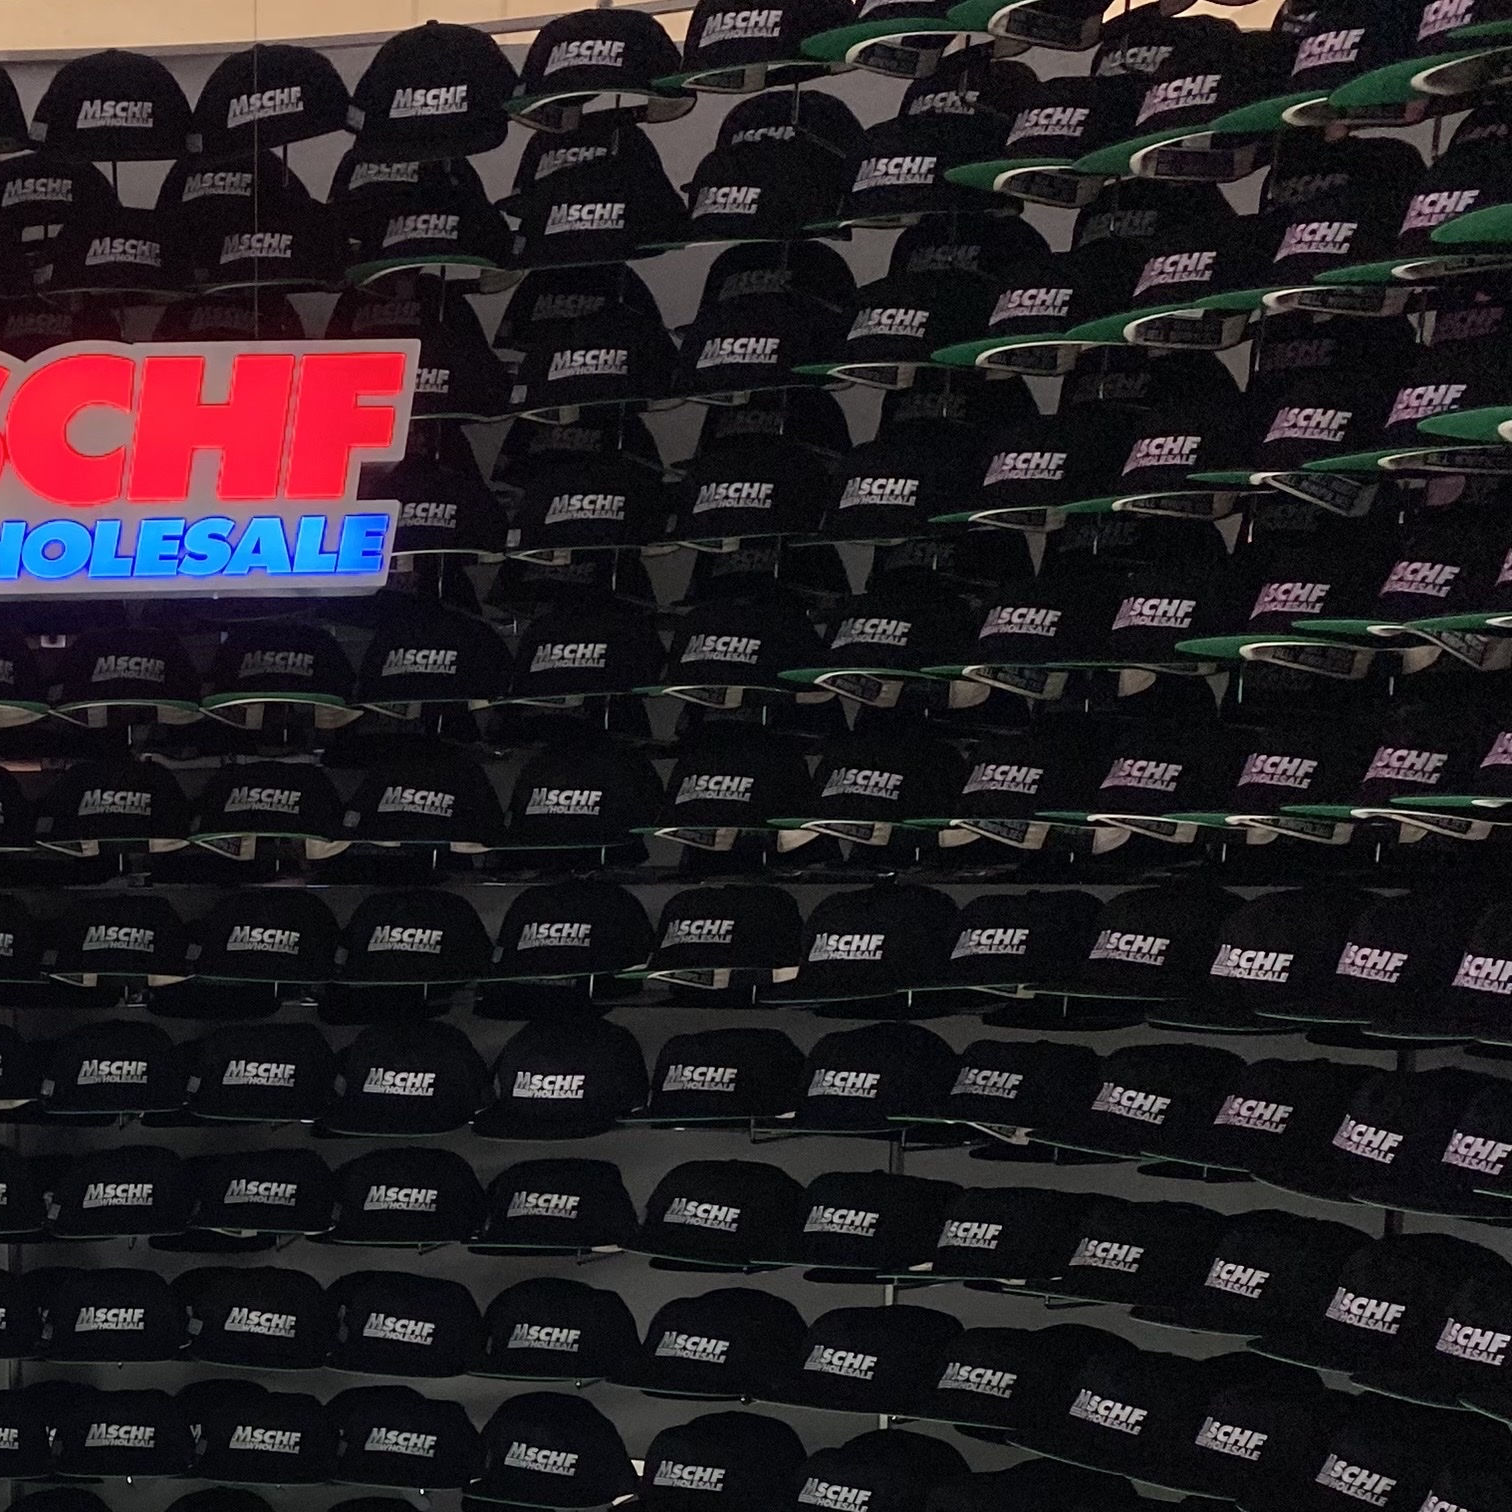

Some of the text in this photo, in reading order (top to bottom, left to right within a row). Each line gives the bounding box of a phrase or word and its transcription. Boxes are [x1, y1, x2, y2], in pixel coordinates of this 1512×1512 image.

[704, 9, 783, 39] MSCHF
[550, 40, 625, 65] MSCHF
[230, 86, 304, 118] MSCHF
[393, 85, 467, 110] MSCHF
[79, 99, 152, 123] MSCHF
[859, 156, 937, 178] MSCHF
[5, 178, 72, 199] MSCHF
[185, 172, 253, 194] MSCHF
[549, 203, 625, 225] MSCHF
[387, 214, 459, 238] MSCHF
[87, 237, 160, 261] MSCHF
[223, 232, 293, 256] MSCHF
[855, 308, 929, 328] MSCHF
[552, 349, 627, 370] MSCHF
[702, 337, 780, 362] MSCHF
[698, 482, 774, 506] MSCHF
[845, 477, 919, 496] MSCHF
[550, 494, 625, 516] MSCHF
[386, 648, 457, 670] MSCHF
[534, 643, 607, 666] MSCHF
[82, 789, 151, 807] MSCHF
[228, 786, 301, 806] MSCHF
[380, 786, 455, 809] MSCHF
[531, 788, 602, 806] MSCHF
[229, 926, 300, 947] MSCHF
[371, 925, 443, 946] MSCHF
[521, 922, 591, 944] MSCHF
[813, 933, 885, 952] MSCHF
[1094, 930, 1170, 956] MSCHF
[1213, 944, 1294, 973] MSCHF
[80, 1059, 147, 1077] MSCHF
[225, 1060, 295, 1079] MSCHF
[367, 1068, 436, 1086] MSCHF
[666, 1064, 737, 1083] MSCHF
[516, 1071, 585, 1089] MSCHF
[812, 1069, 880, 1090] MSCHF
[86, 1183, 153, 1200] MSCHF
[227, 1179, 297, 1198] MSCHF
[367, 1185, 438, 1204] MSCHF
[511, 1191, 580, 1210] MSCHF
[670, 1198, 740, 1223] MSCHF
[807, 1205, 879, 1228] MSCHF
[78, 1307, 144, 1324] MSCHF
[225, 1307, 296, 1331] MSCHF
[364, 1313, 435, 1338] MSCHF
[510, 1323, 581, 1344] MSCHF
[657, 1331, 729, 1356] MSCHF
[805, 1345, 877, 1372] MSCHF
[940, 1362, 1017, 1390] MSCHF
[1069, 1389, 1148, 1427] MSCHF
[88, 1423, 155, 1441] MSCHF
[231, 1426, 301, 1447] MSCHF
[366, 1427, 437, 1450] MSCHF
[505, 1442, 578, 1467] MSCHF
[655, 1460, 725, 1484] MSCHF
[798, 1478, 872, 1506] MSCHF
